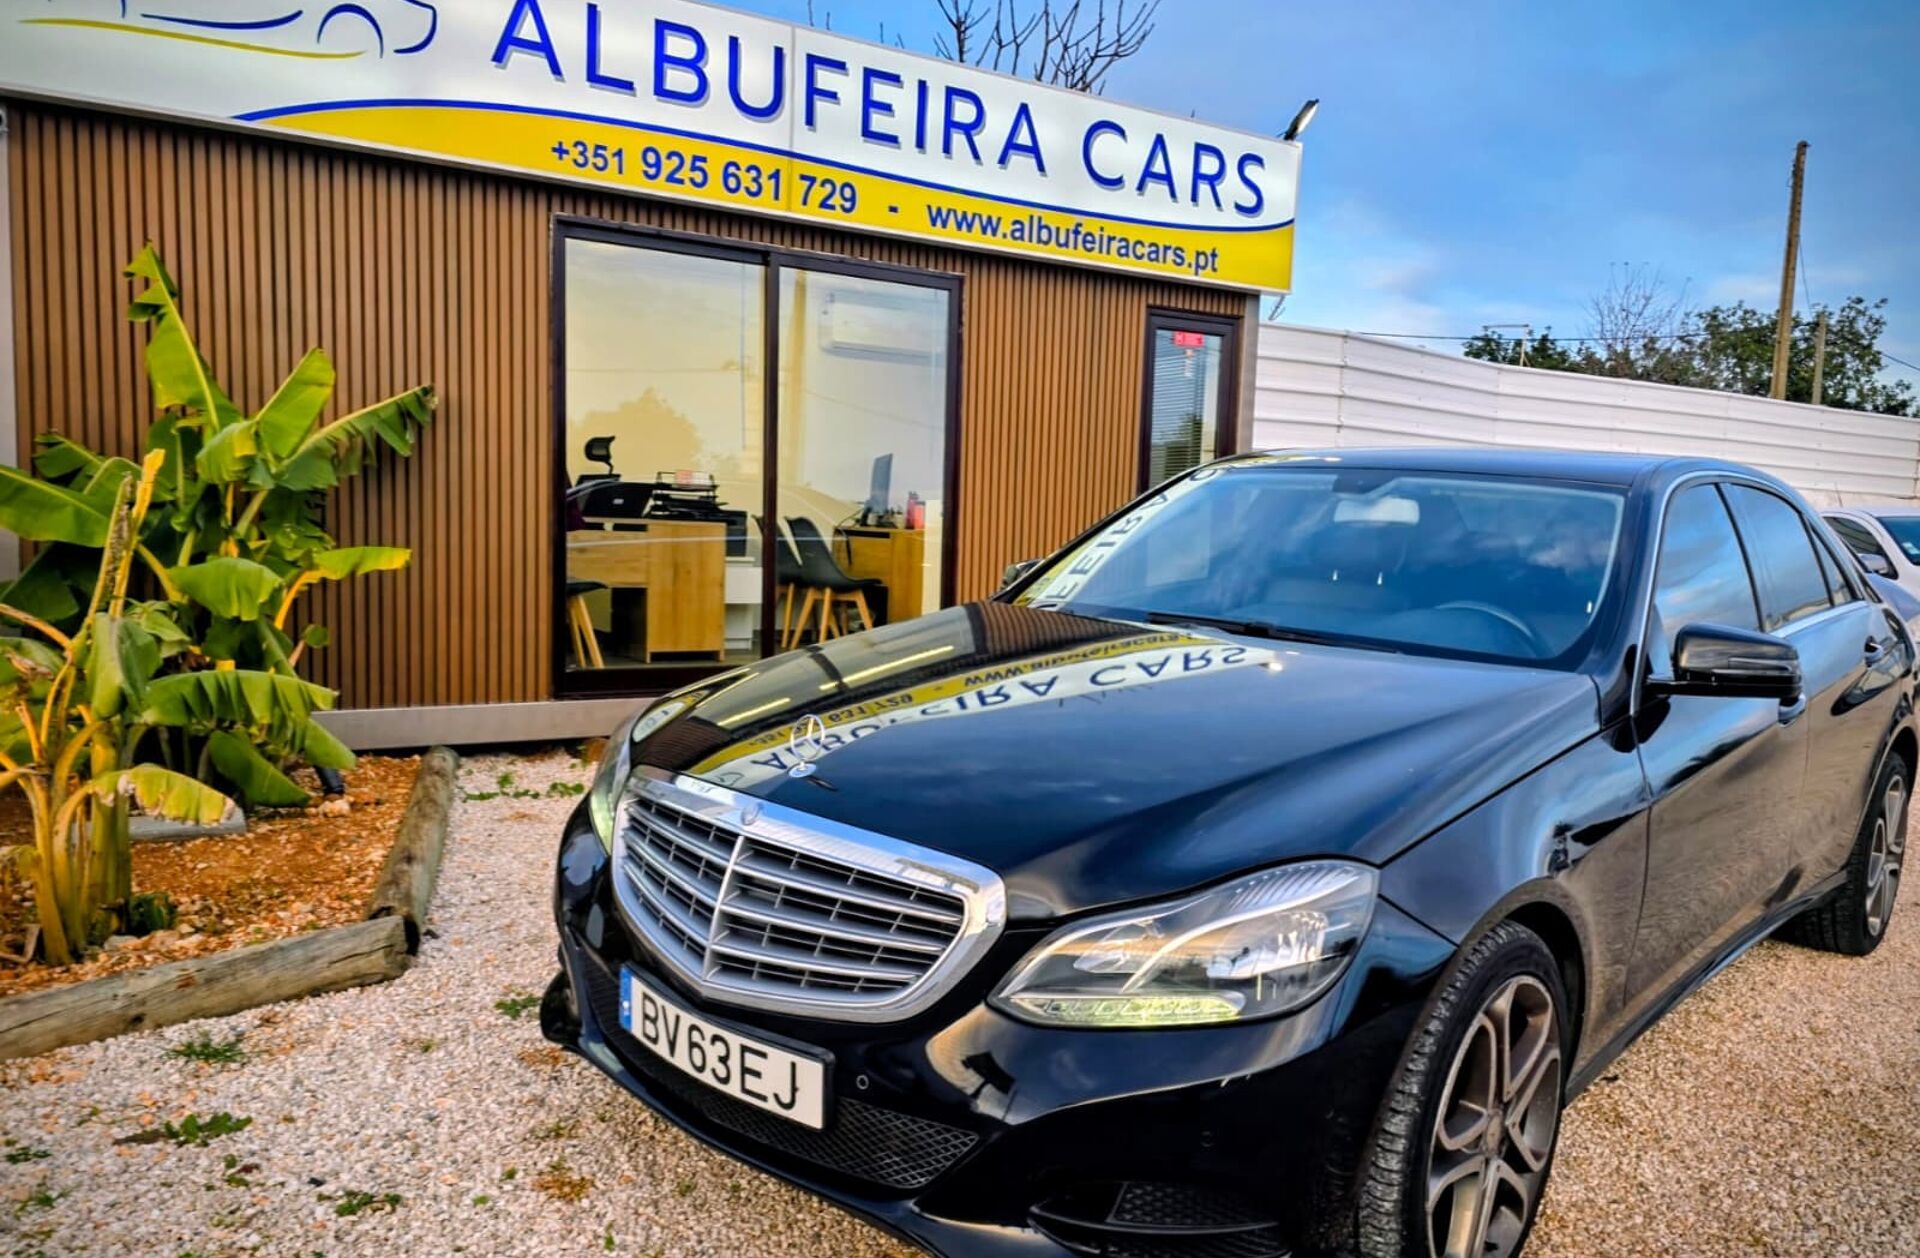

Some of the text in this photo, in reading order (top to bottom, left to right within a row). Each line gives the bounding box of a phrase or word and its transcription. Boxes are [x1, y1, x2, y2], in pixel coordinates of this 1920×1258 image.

[492, 0, 1266, 218] ALBUFEIRA CARS
[551, 140, 624, 176] +351
[641, 146, 709, 189] 925
[722, 160, 782, 202] 631
[799, 173, 858, 214] 729
[926, 203, 1218, 276] www.albufeiracars.pt
[641, 990, 799, 1111] BV63EJ
